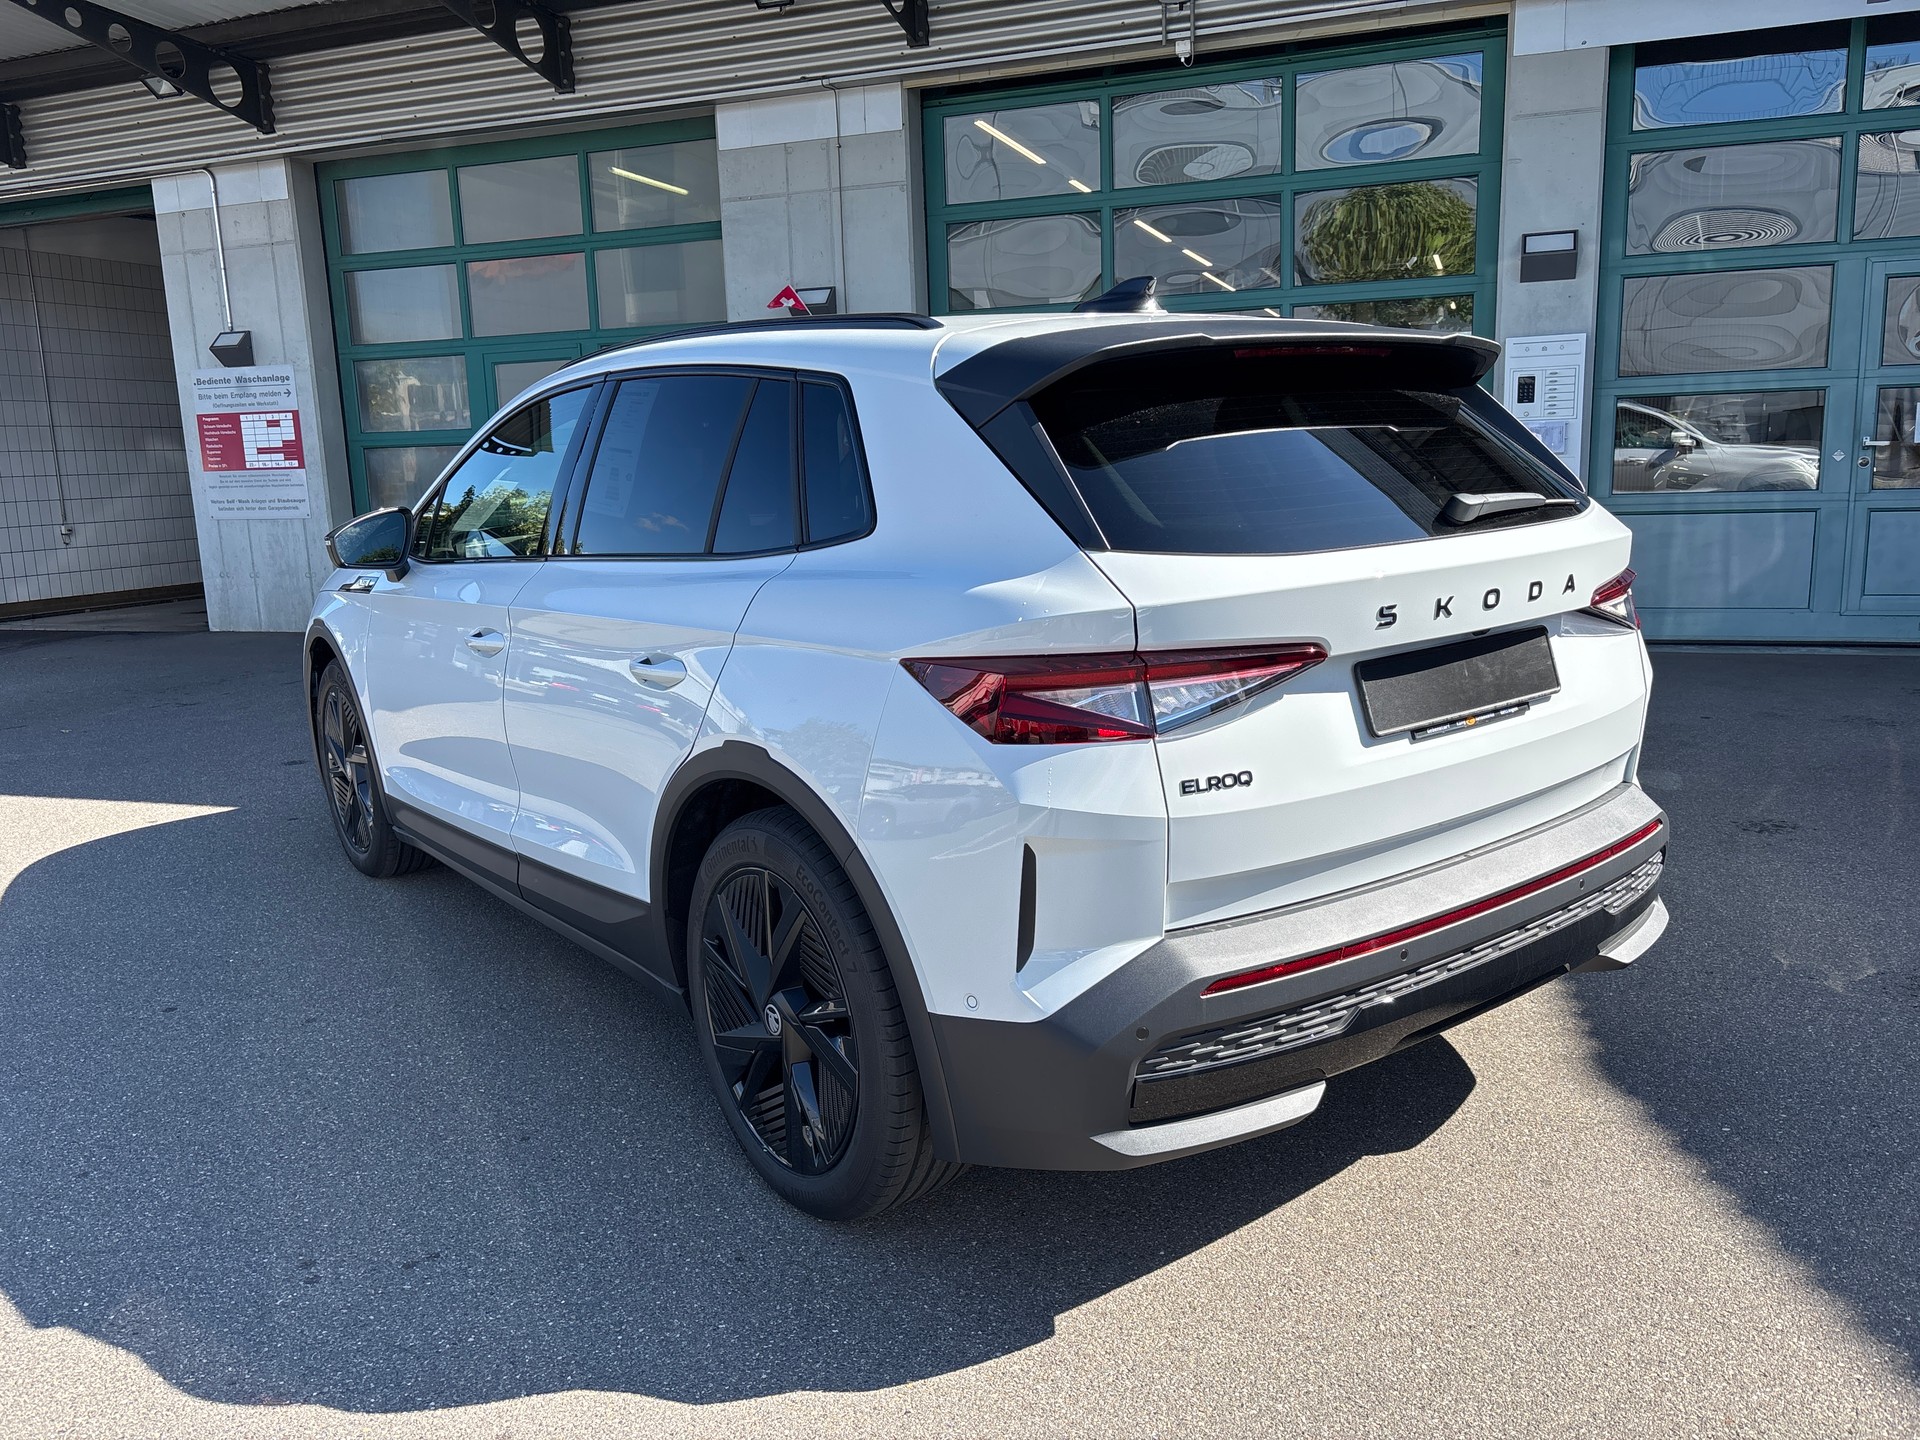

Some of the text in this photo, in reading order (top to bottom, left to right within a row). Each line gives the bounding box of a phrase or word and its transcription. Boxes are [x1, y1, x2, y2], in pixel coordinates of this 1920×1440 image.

[196, 374, 290, 386] Bediente Waschanlage
[198, 393, 212, 401] Bitte
[214, 391, 228, 400] beim
[230, 390, 257, 400] Empfang
[1179, 770, 1254, 797] ELROQ
